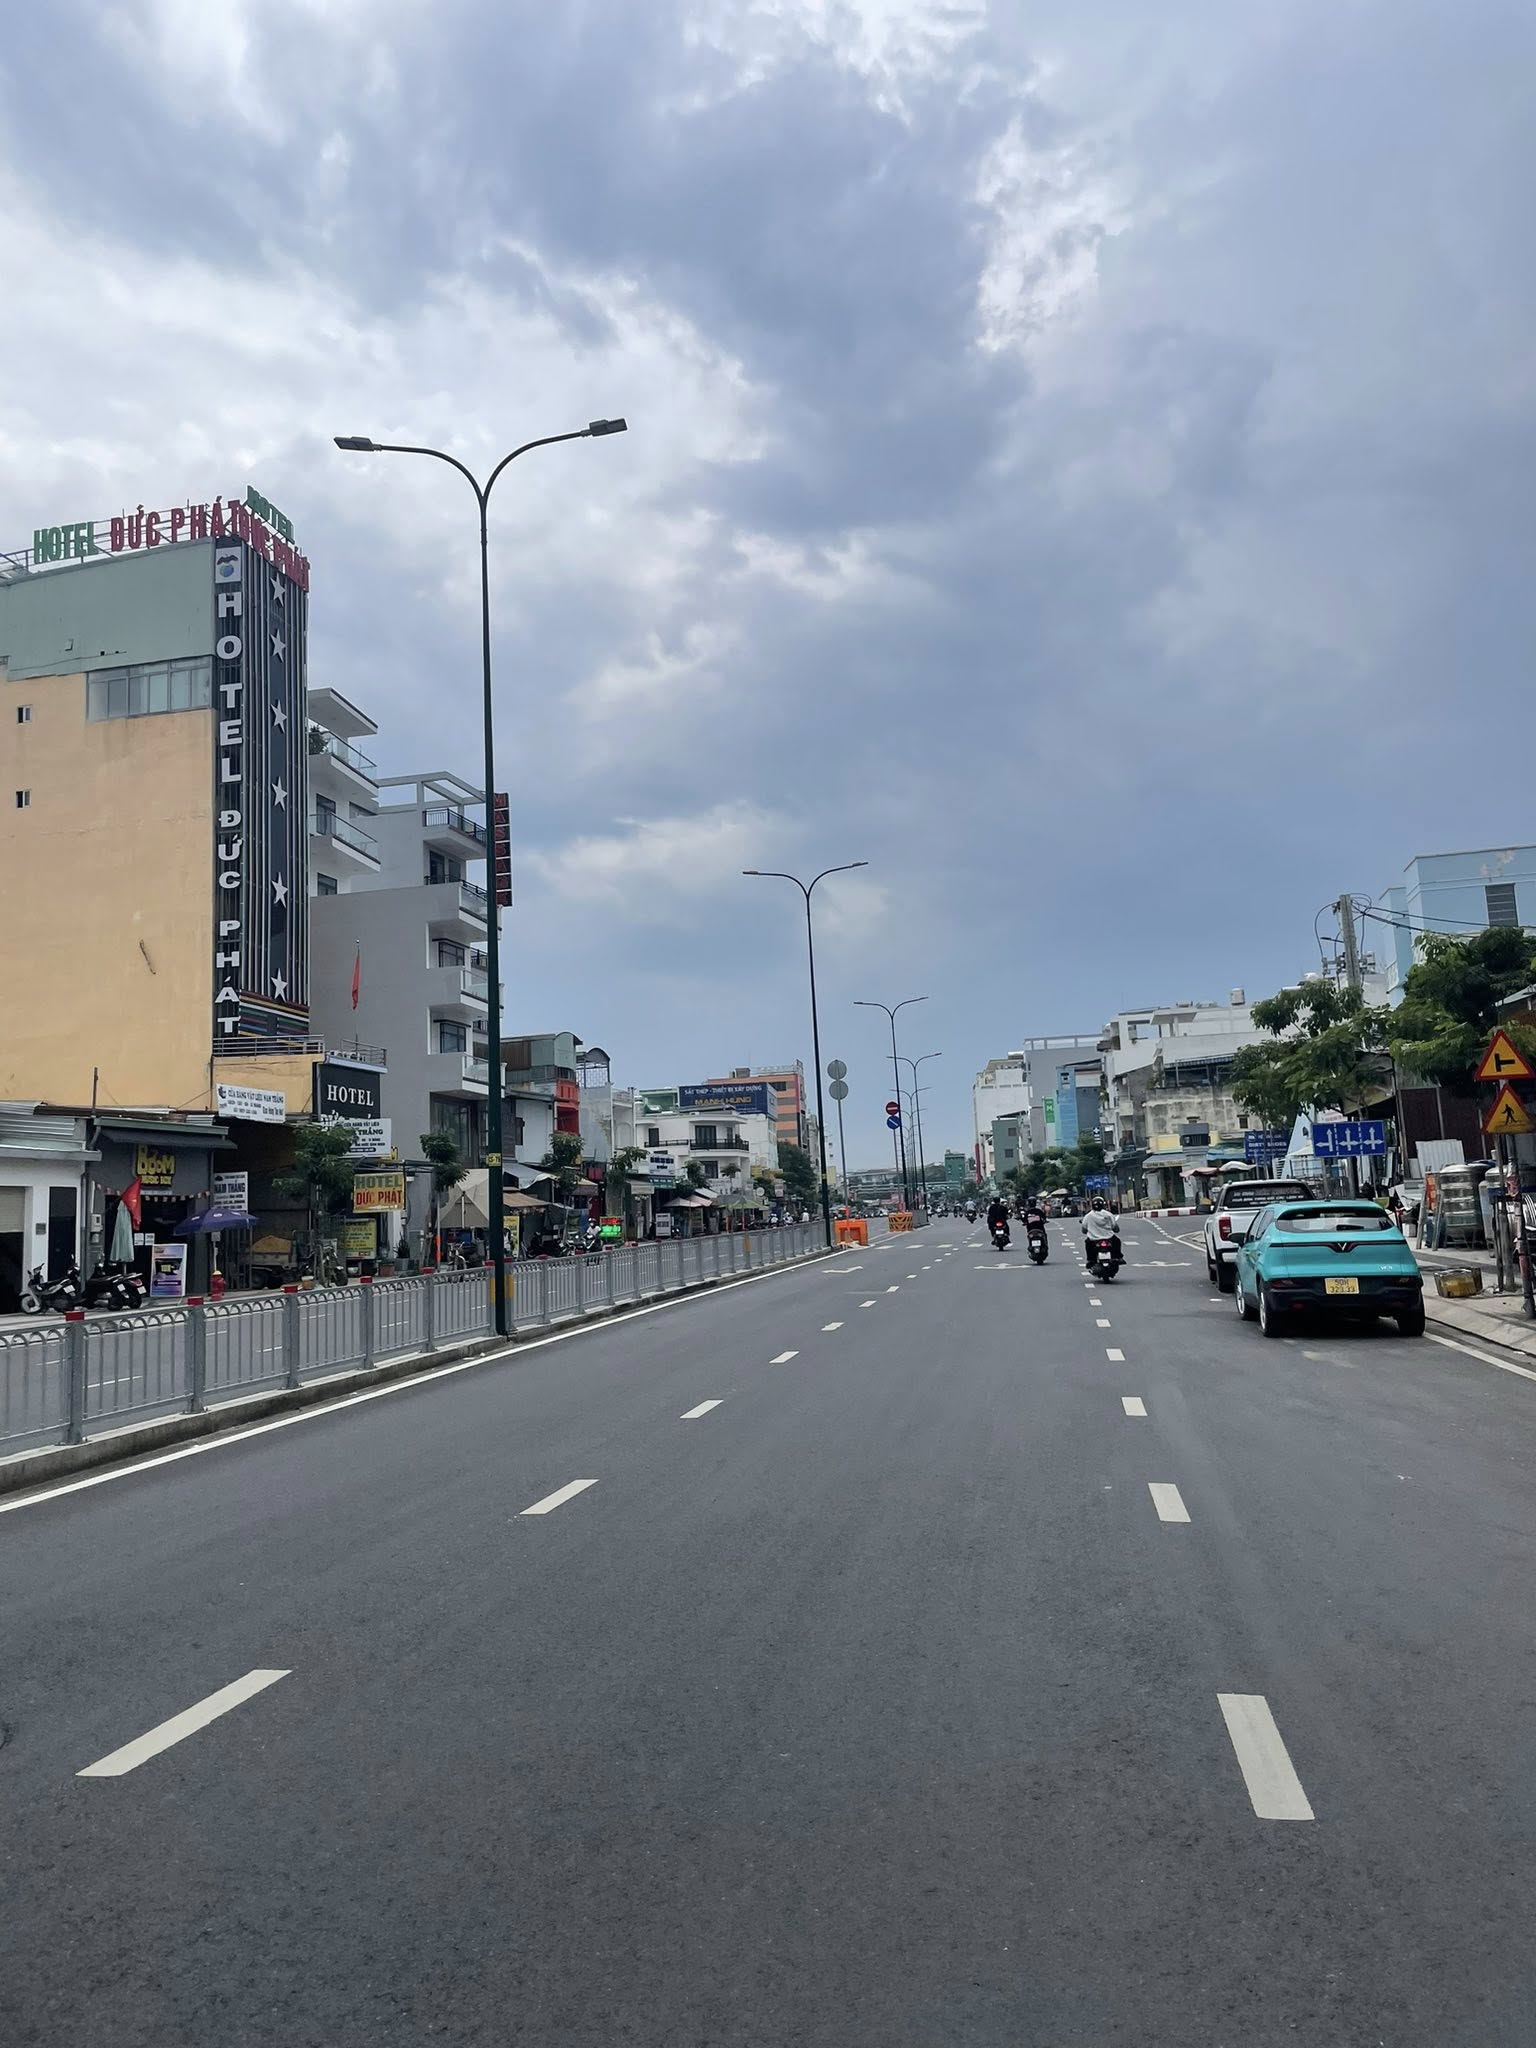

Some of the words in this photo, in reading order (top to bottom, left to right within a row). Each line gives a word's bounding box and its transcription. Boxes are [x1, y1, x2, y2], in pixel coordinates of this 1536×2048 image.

[33, 521, 99, 565] HOTEL
[110, 504, 161, 552] ĐỨC
[171, 495, 241, 544] PHÁT
[216, 591, 243, 783] HOTEL
[217, 809, 243, 889] ĐỨC
[214, 919, 241, 1034] PHÁT
[327, 1084, 374, 1107] HOTEL
[355, 1174, 403, 1189] HOTEL
[378, 1187, 403, 1204] PHÁT
